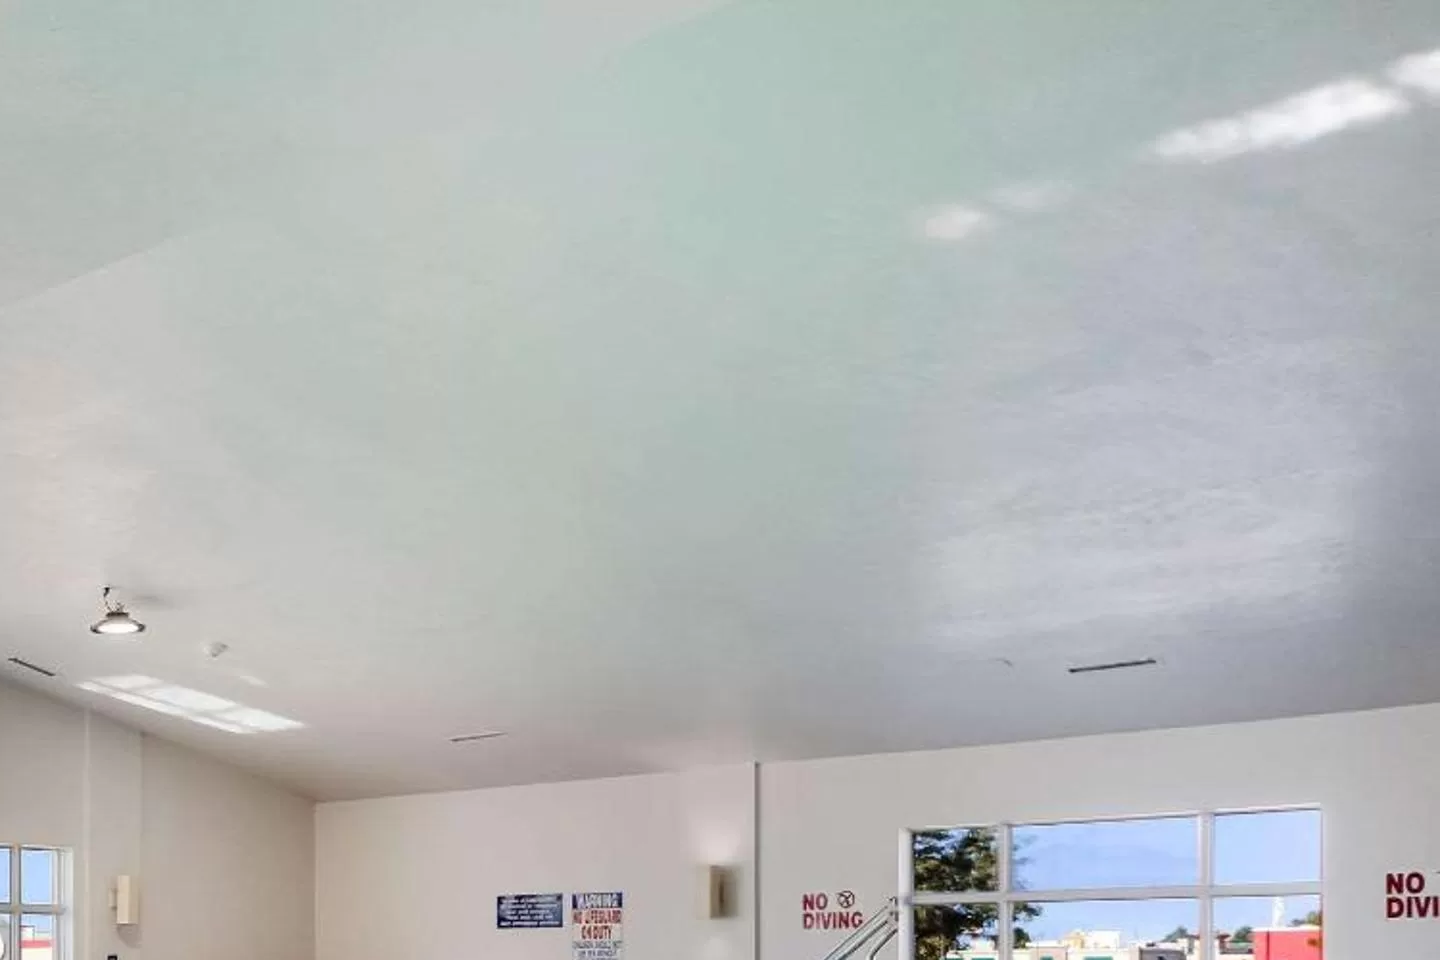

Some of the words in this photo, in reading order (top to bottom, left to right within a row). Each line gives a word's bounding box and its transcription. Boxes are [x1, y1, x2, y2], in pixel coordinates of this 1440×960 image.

[1386, 872, 1425, 895] NO
[803, 892, 828, 911] NO
[1386, 896, 1440, 919] DIVI
[803, 911, 863, 930] DIVING
